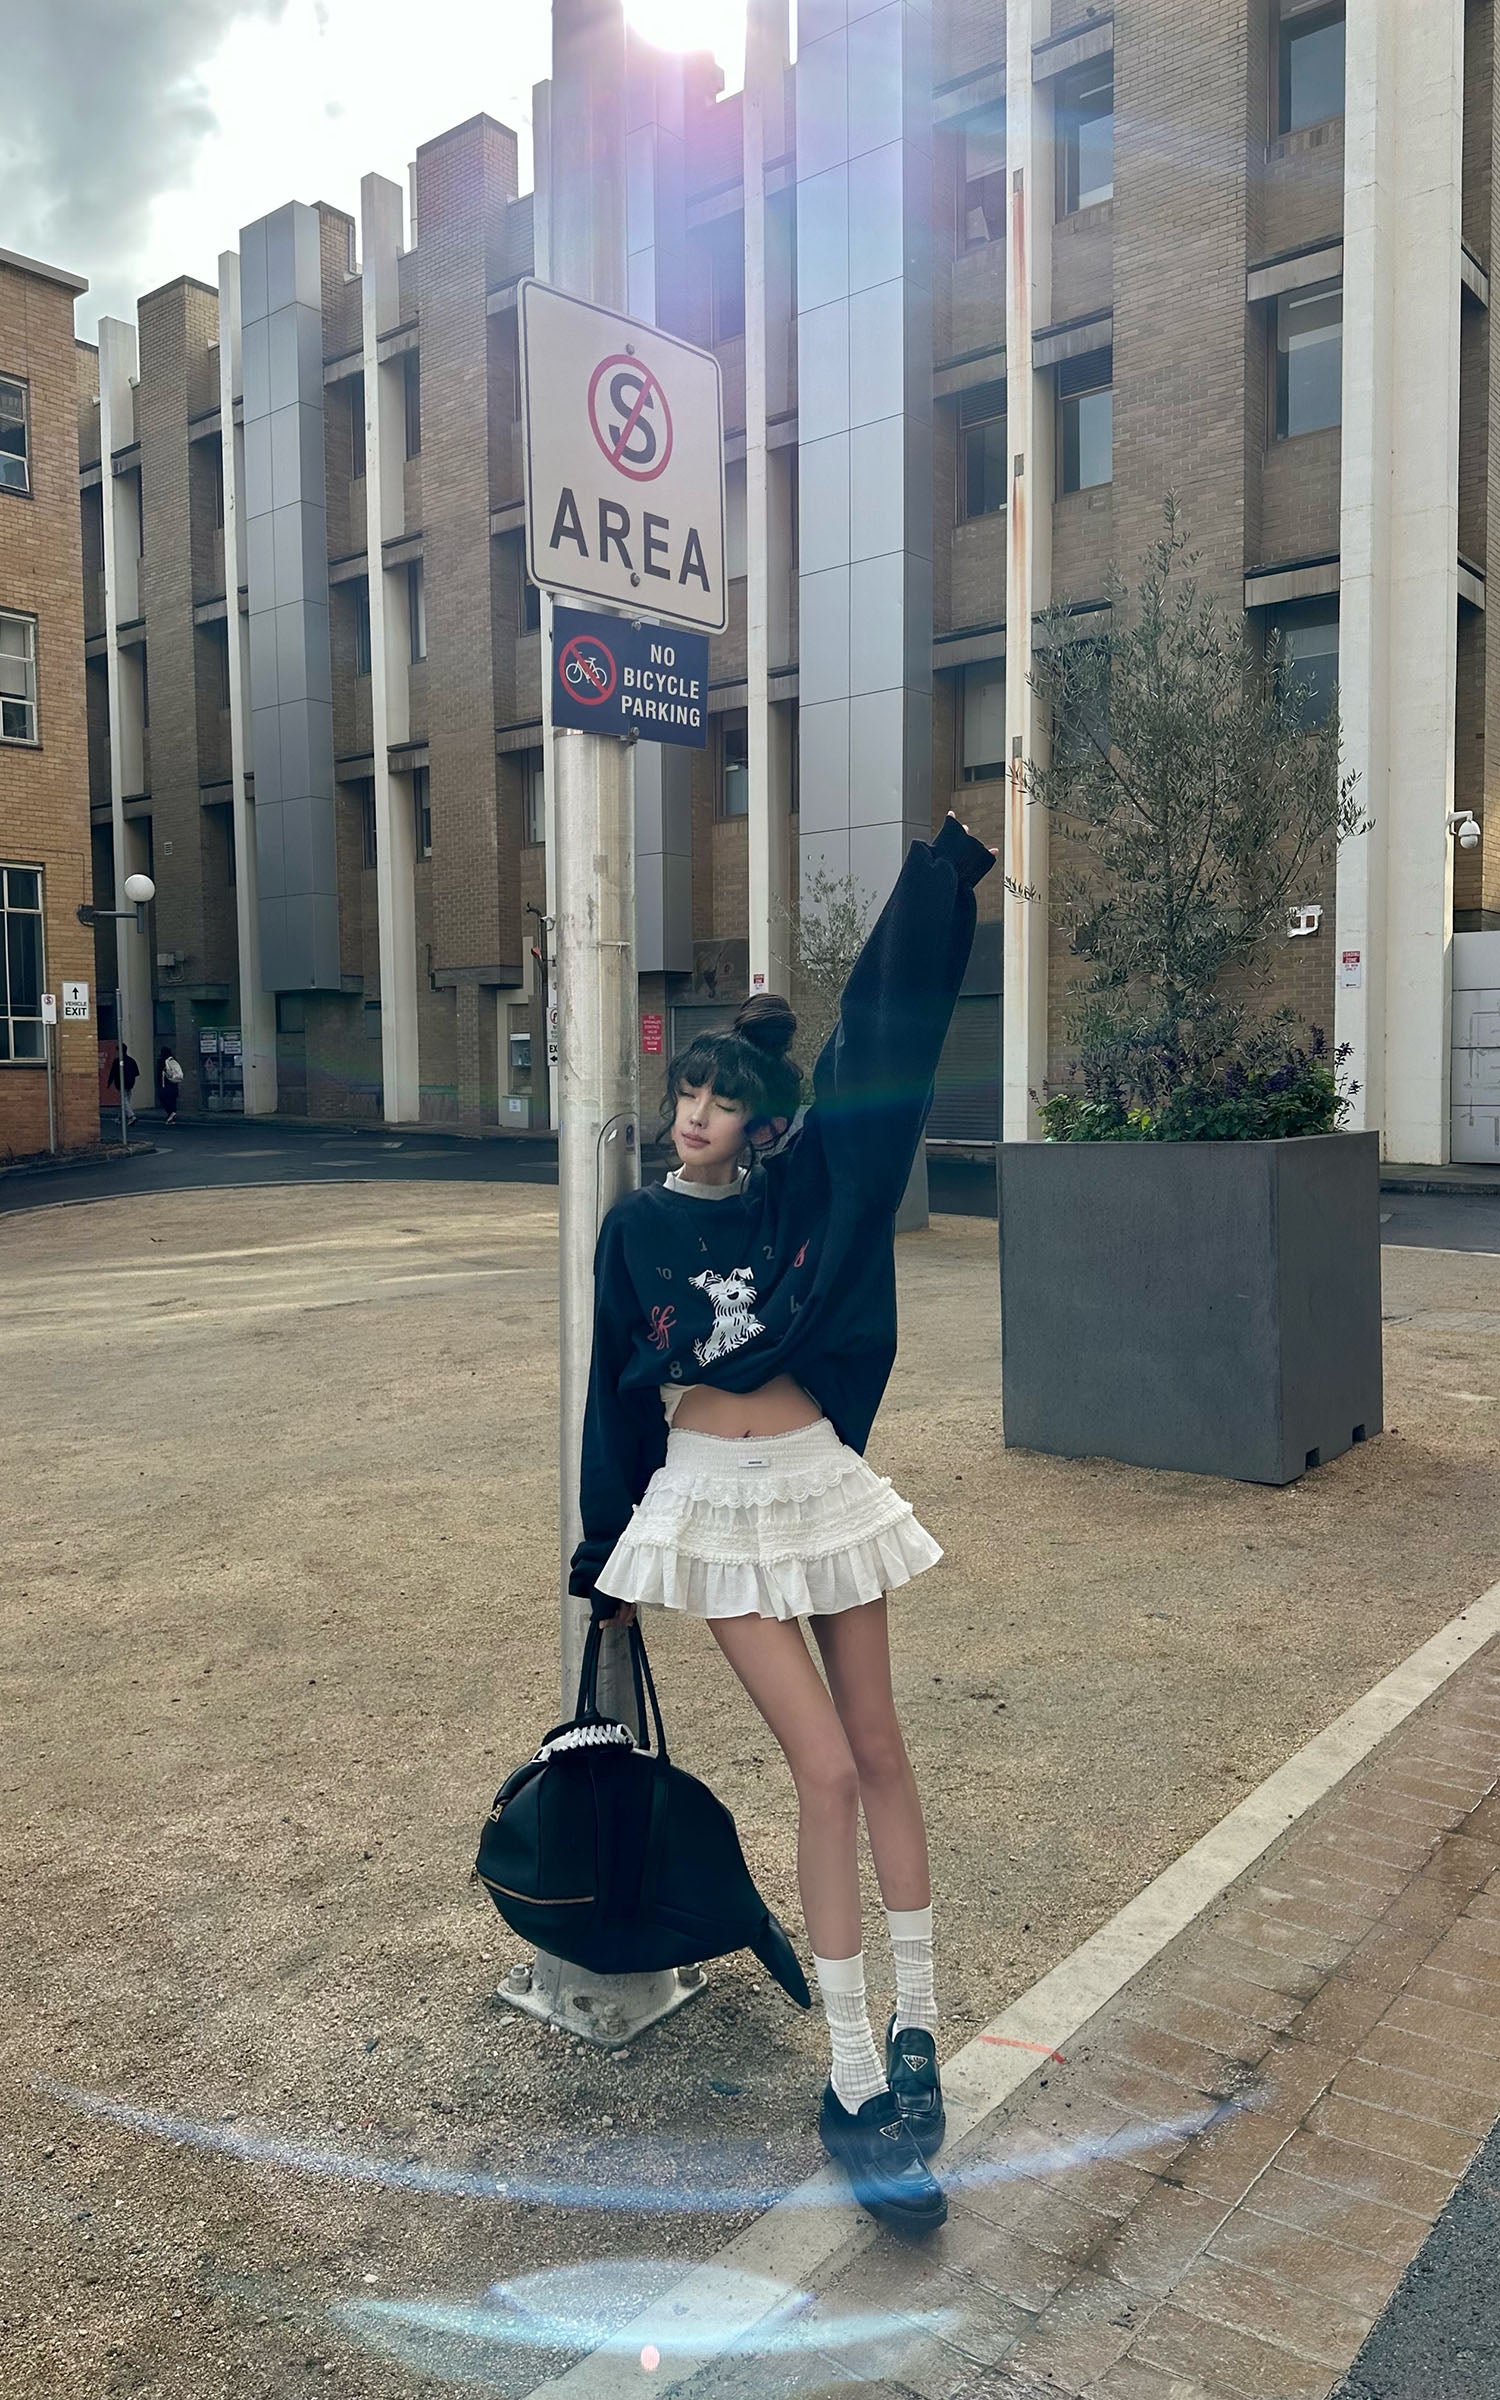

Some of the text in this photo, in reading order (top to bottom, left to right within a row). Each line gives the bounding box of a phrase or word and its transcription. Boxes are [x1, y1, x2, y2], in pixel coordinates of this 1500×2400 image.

[609, 373, 657, 464] S
[549, 487, 711, 593] AREA
[650, 643, 675, 667] NO
[623, 667, 700, 700] BICYCLE
[621, 695, 701, 728] PARKING
[65, 1007, 87, 1016] EXIT
[762, 1245, 775, 1261] 2
[656, 1267, 672, 1280] 10
[669, 1360, 683, 1379] 8
